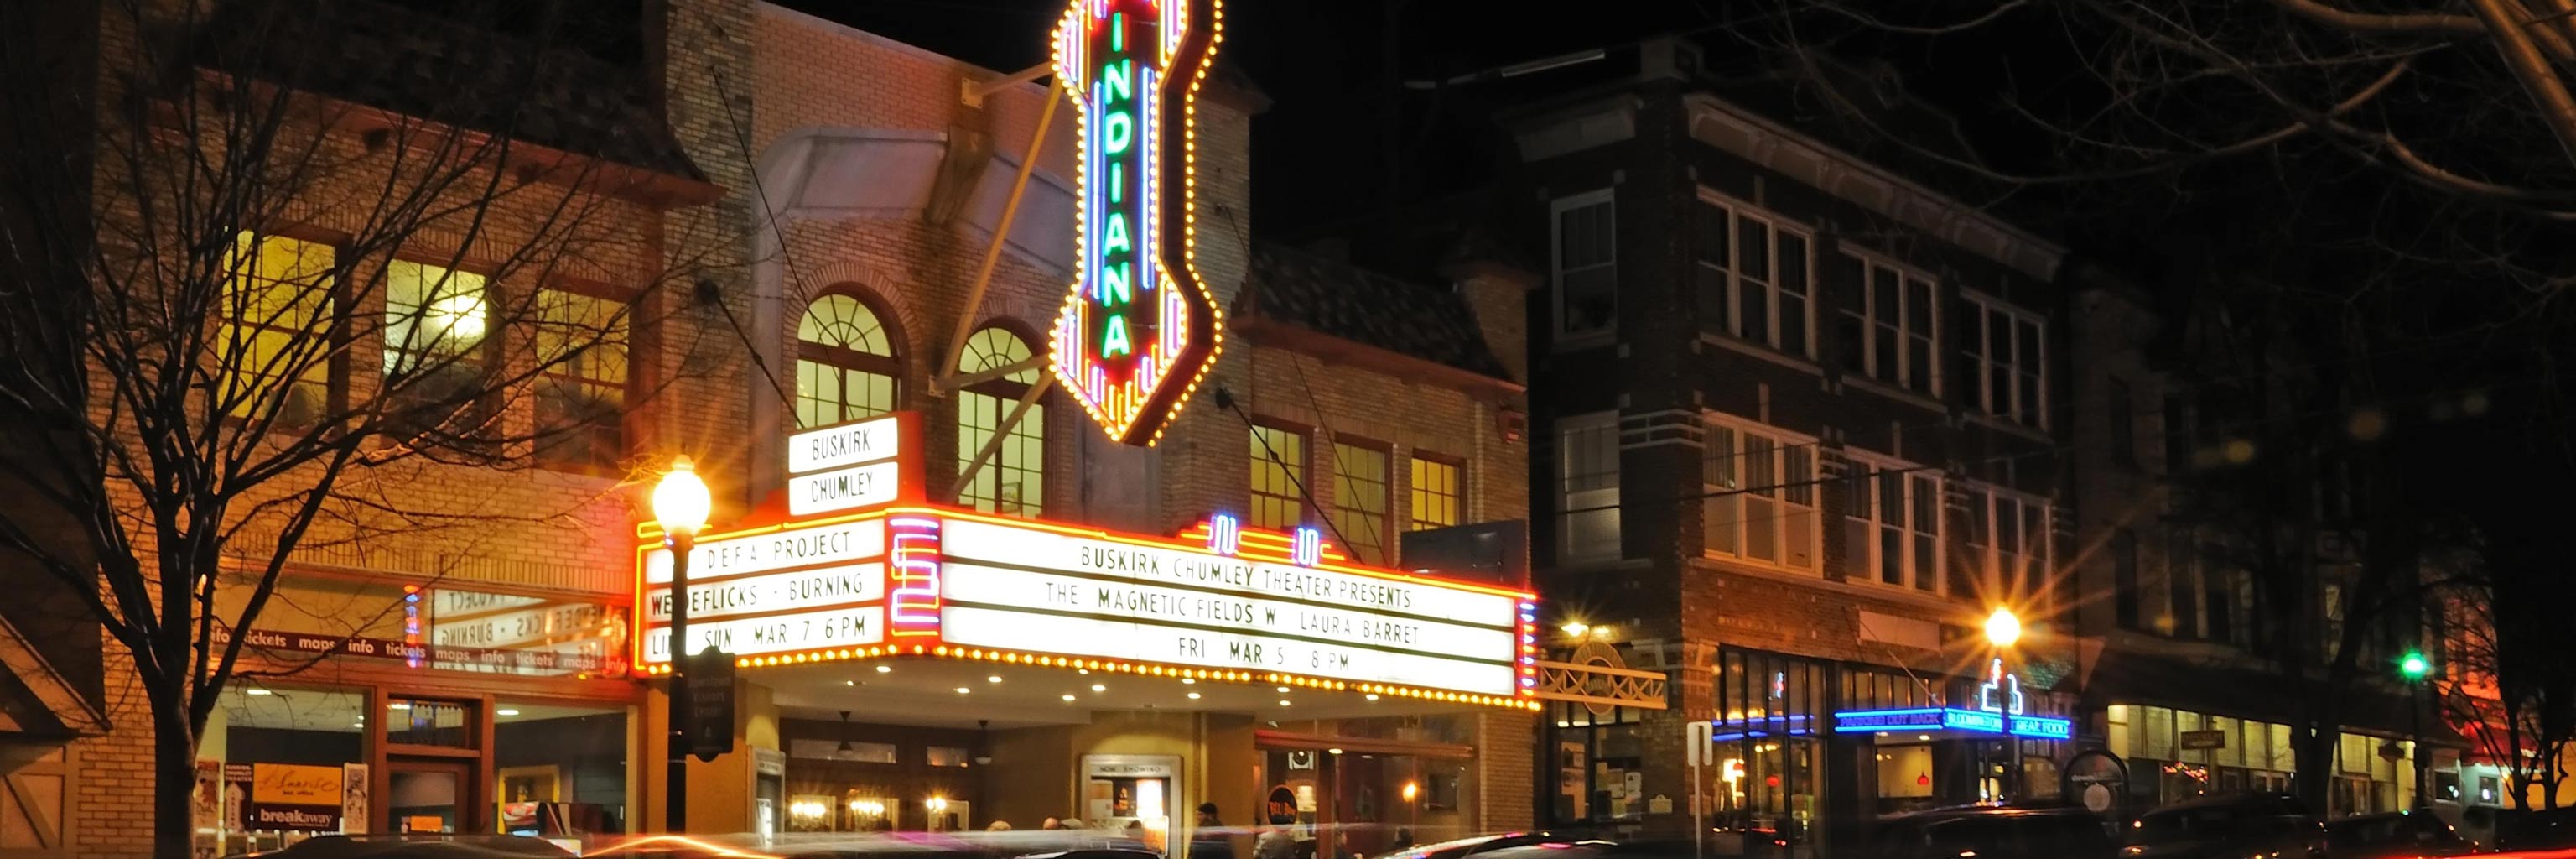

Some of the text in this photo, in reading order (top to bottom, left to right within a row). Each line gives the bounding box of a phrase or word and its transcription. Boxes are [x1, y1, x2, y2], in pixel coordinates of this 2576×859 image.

[1102, 12, 1132, 360] INDIANA
[813, 429, 870, 461] BUSKIRK
[811, 472, 873, 502] CHUMLEY
[708, 531, 851, 569] DEFA PROJECT
[790, 573, 863, 600] BURNING
[1082, 546, 1410, 607] BUSKIRK CHUMLEY THEATER PRESENTS
[1046, 582, 1419, 644] THE MAGNETIC FIELDS W LAURA BARRET
[705, 628, 732, 648] SUN
[755, 623, 787, 645] MAR
[802, 621, 810, 641] 7
[826, 618, 833, 638] 6
[842, 616, 865, 638] PM
[244, 631, 287, 648] ickets
[299, 635, 335, 651] maps
[348, 639, 374, 653] info
[386, 641, 426, 659] tickets
[436, 648, 470, 661] maps
[481, 651, 505, 664] info
[517, 653, 553, 667] tickets
[564, 657, 596, 669] maps
[1179, 637, 1348, 671] FRI MAR 5 8 PM
[260, 808, 333, 827] breakaway
